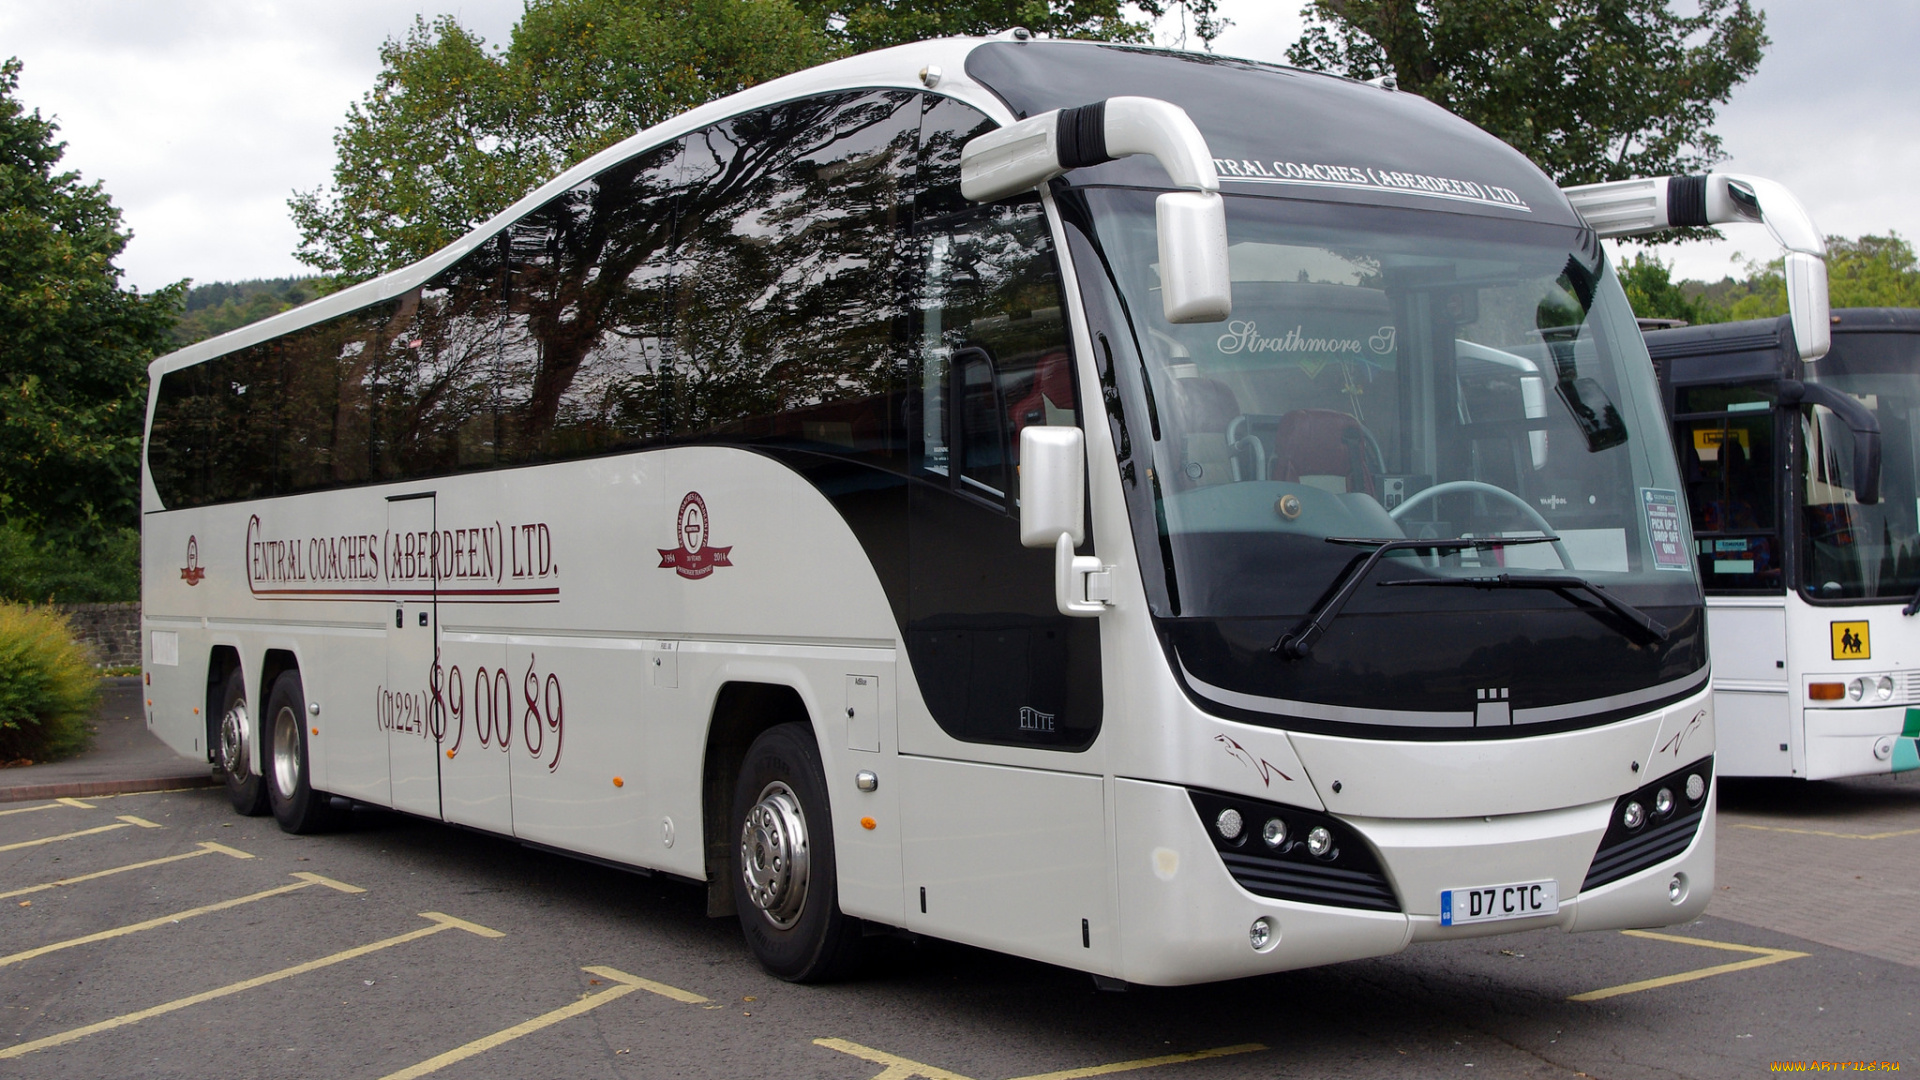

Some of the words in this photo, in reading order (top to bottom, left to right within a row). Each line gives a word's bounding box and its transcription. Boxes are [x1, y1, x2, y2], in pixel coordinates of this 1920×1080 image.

[1213, 158, 1277, 177] TRAL
[1273, 161, 1369, 184] COACHES
[1366, 167, 1486, 200] (ABERDEEN)
[1483, 184, 1527, 206] LTD.
[1217, 320, 1362, 354] Strathmore
[1651, 518, 1664, 530] PICK
[1664, 519, 1672, 531] UP
[246, 513, 306, 593] CENTRAL
[309, 534, 379, 580] COACHES
[384, 520, 503, 585] (ABERDEEN)
[511, 523, 558, 577] LTD.
[664, 553, 676, 563] 1984
[714, 553, 726, 562] 2014
[475, 666, 512, 751] 00
[524, 652, 565, 772] 89
[1020, 708, 1055, 730] ELITE
[1470, 889, 1496, 916] D7
[1503, 885, 1542, 912] CTC
